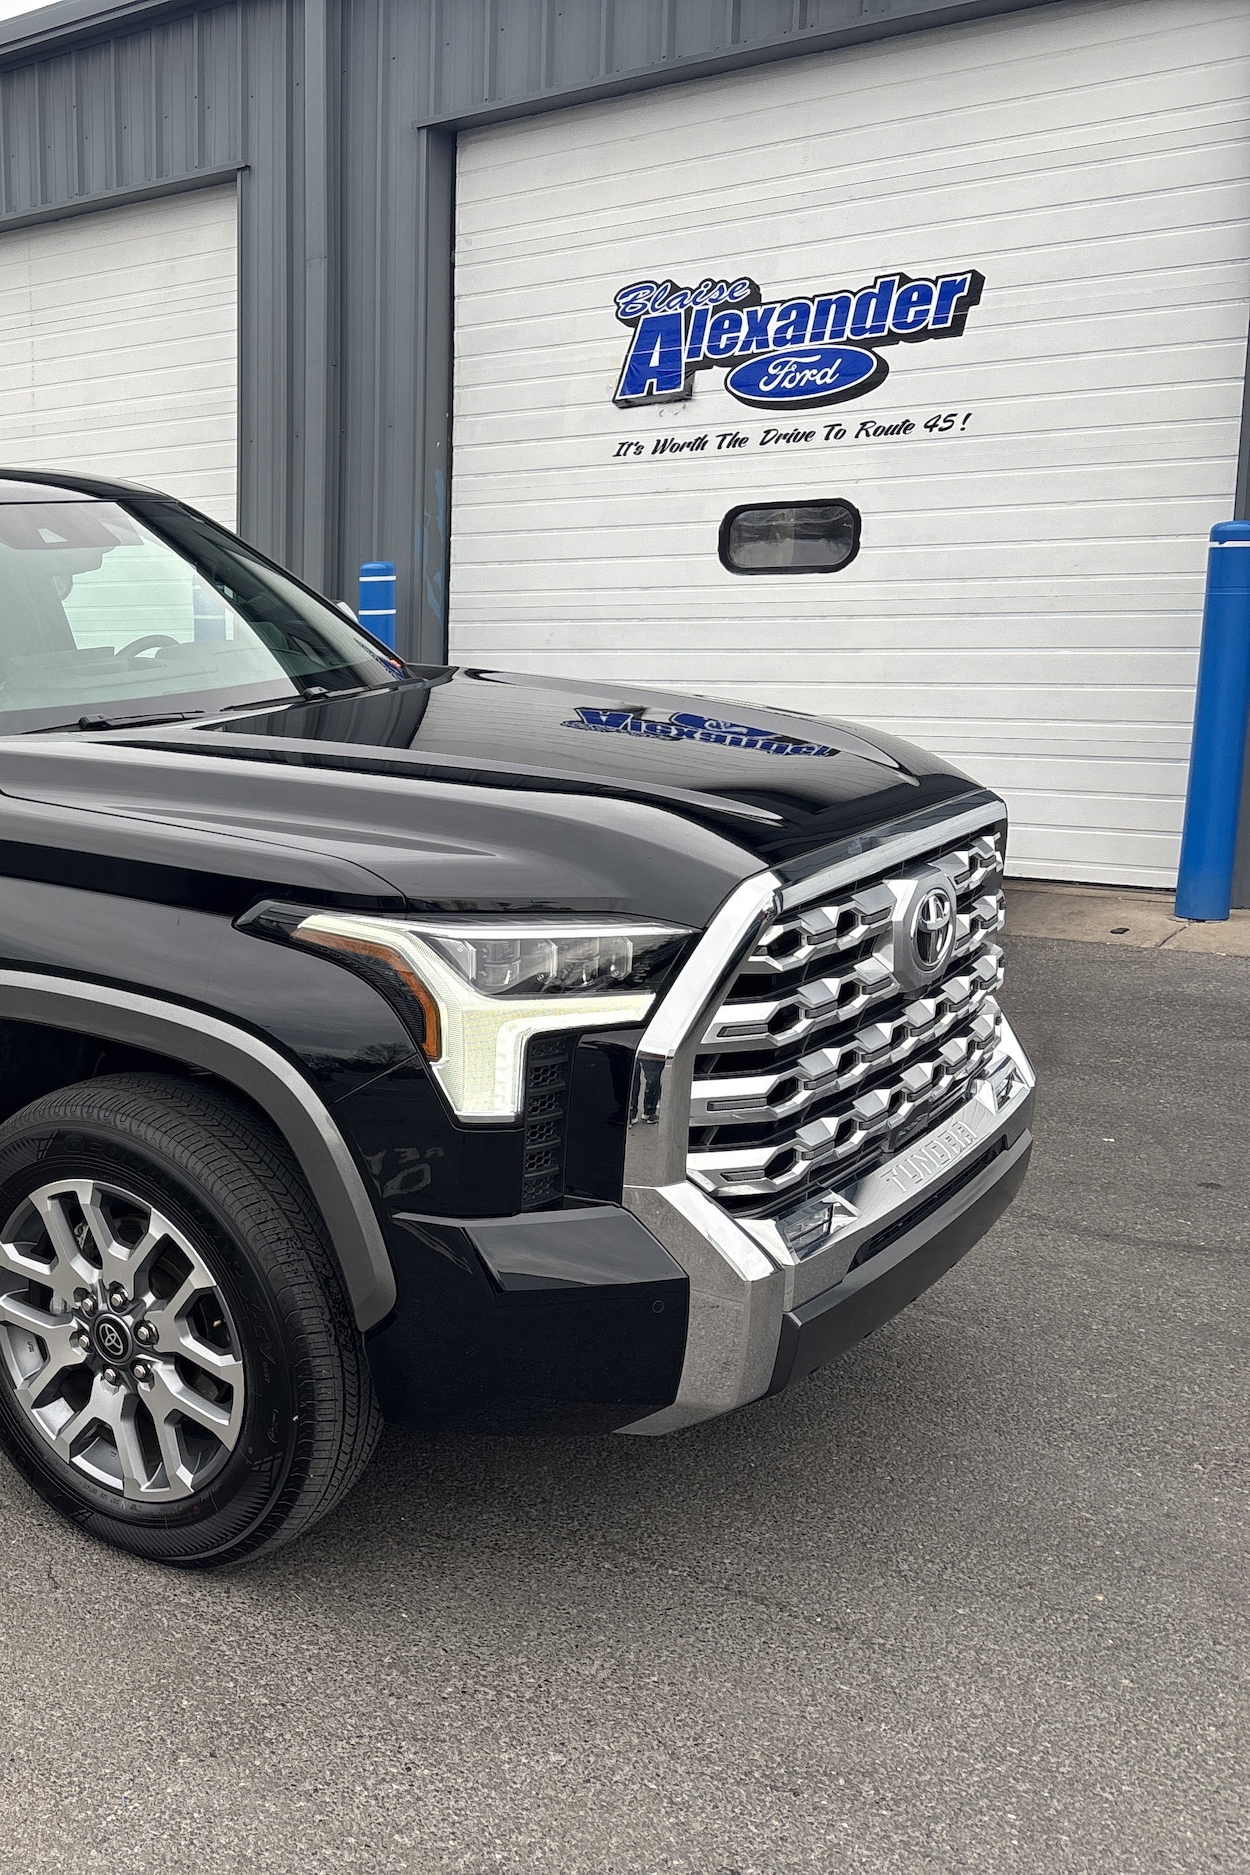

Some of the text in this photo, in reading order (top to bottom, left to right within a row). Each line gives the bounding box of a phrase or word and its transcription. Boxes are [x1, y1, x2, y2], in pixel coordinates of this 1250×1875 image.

[614, 278, 753, 320] Blaise
[614, 270, 978, 401] Alexander
[758, 356, 842, 393] Ford
[612, 441, 645, 458] It's
[650, 436, 710, 456] Worth
[715, 432, 750, 450] The
[759, 427, 817, 447] Drive
[822, 423, 848, 441] To
[854, 418, 916, 440] Route
[879, 1120, 978, 1194] TUNDRA
